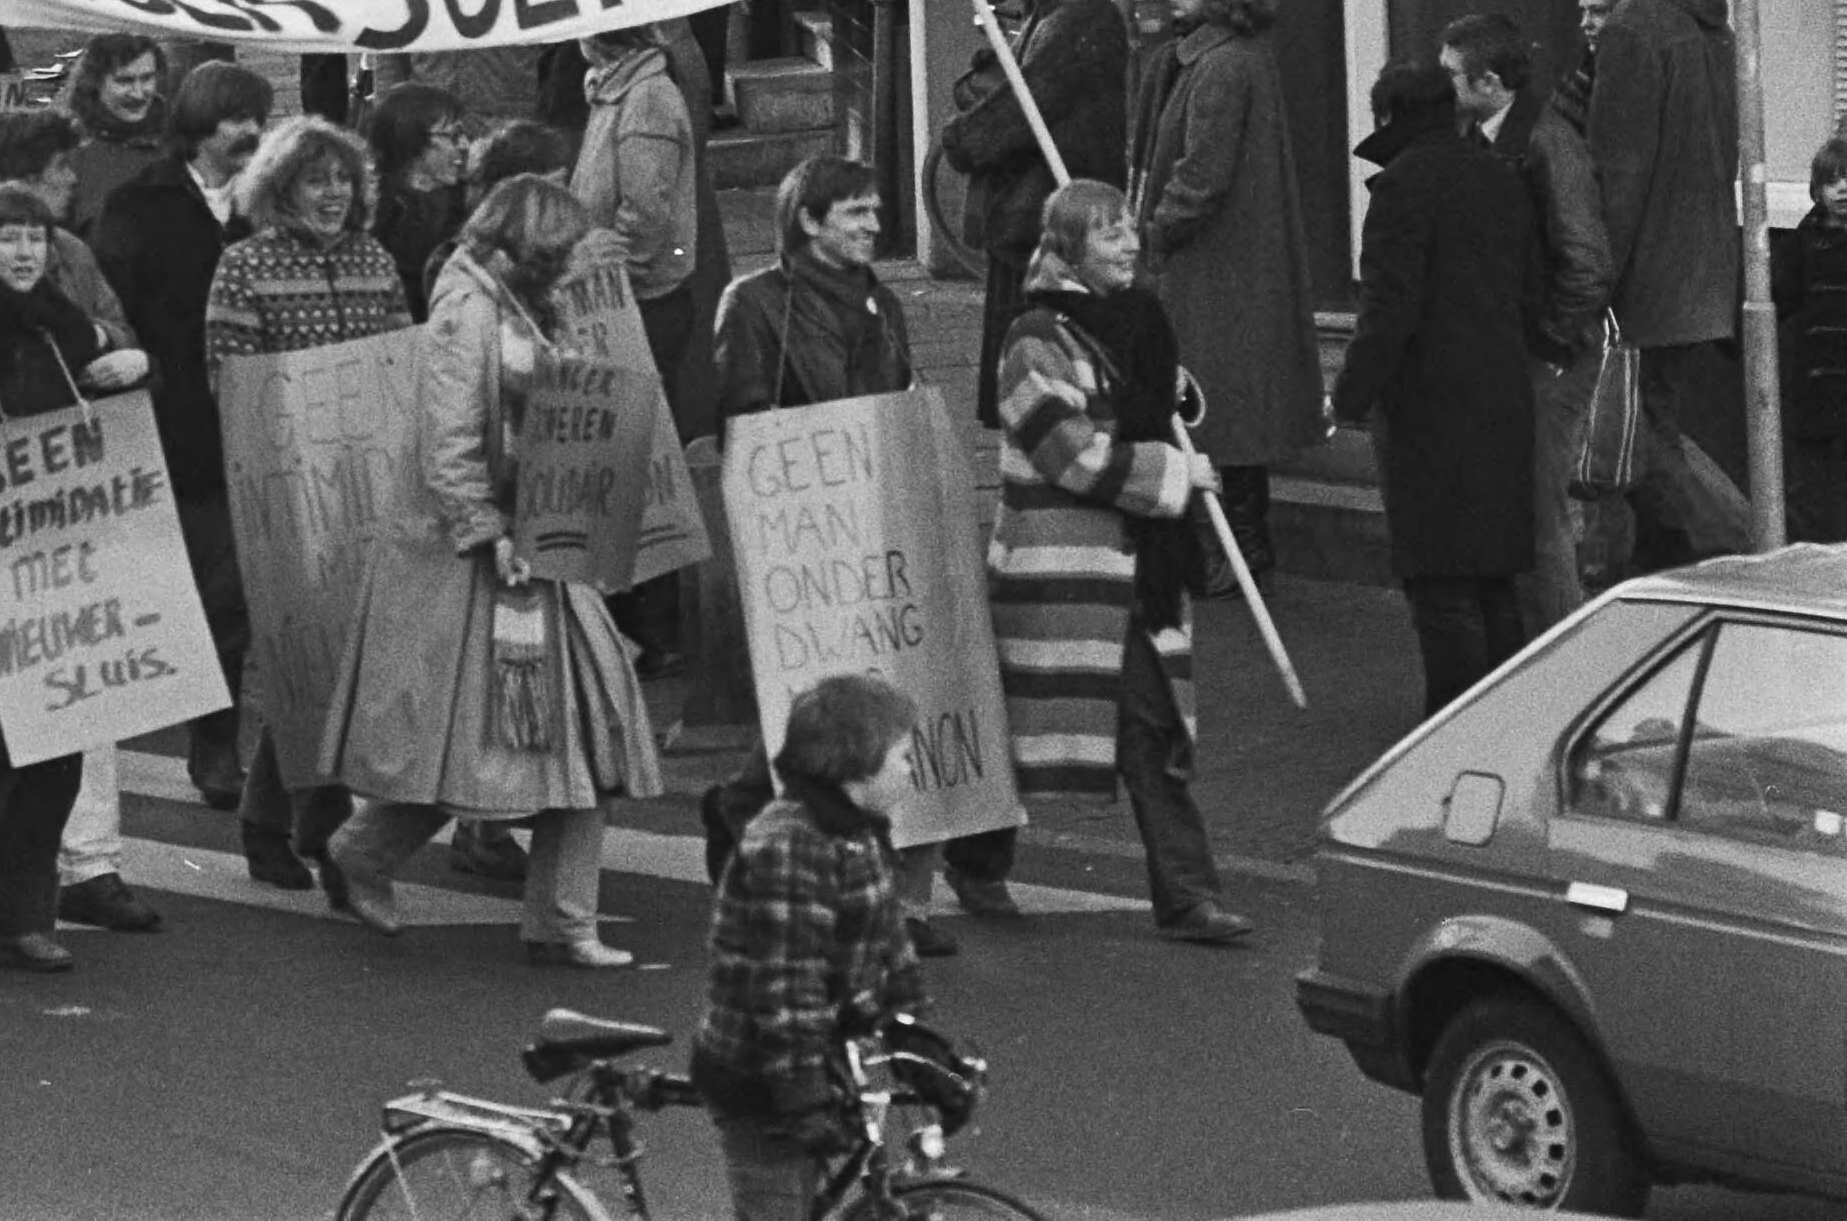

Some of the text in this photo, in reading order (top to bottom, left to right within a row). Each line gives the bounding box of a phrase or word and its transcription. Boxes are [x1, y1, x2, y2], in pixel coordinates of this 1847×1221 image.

[749, 421, 873, 498] GEEN
[757, 501, 861, 556] MAN
[764, 549, 911, 613] ONDER
[773, 601, 923, 671] DWANG
